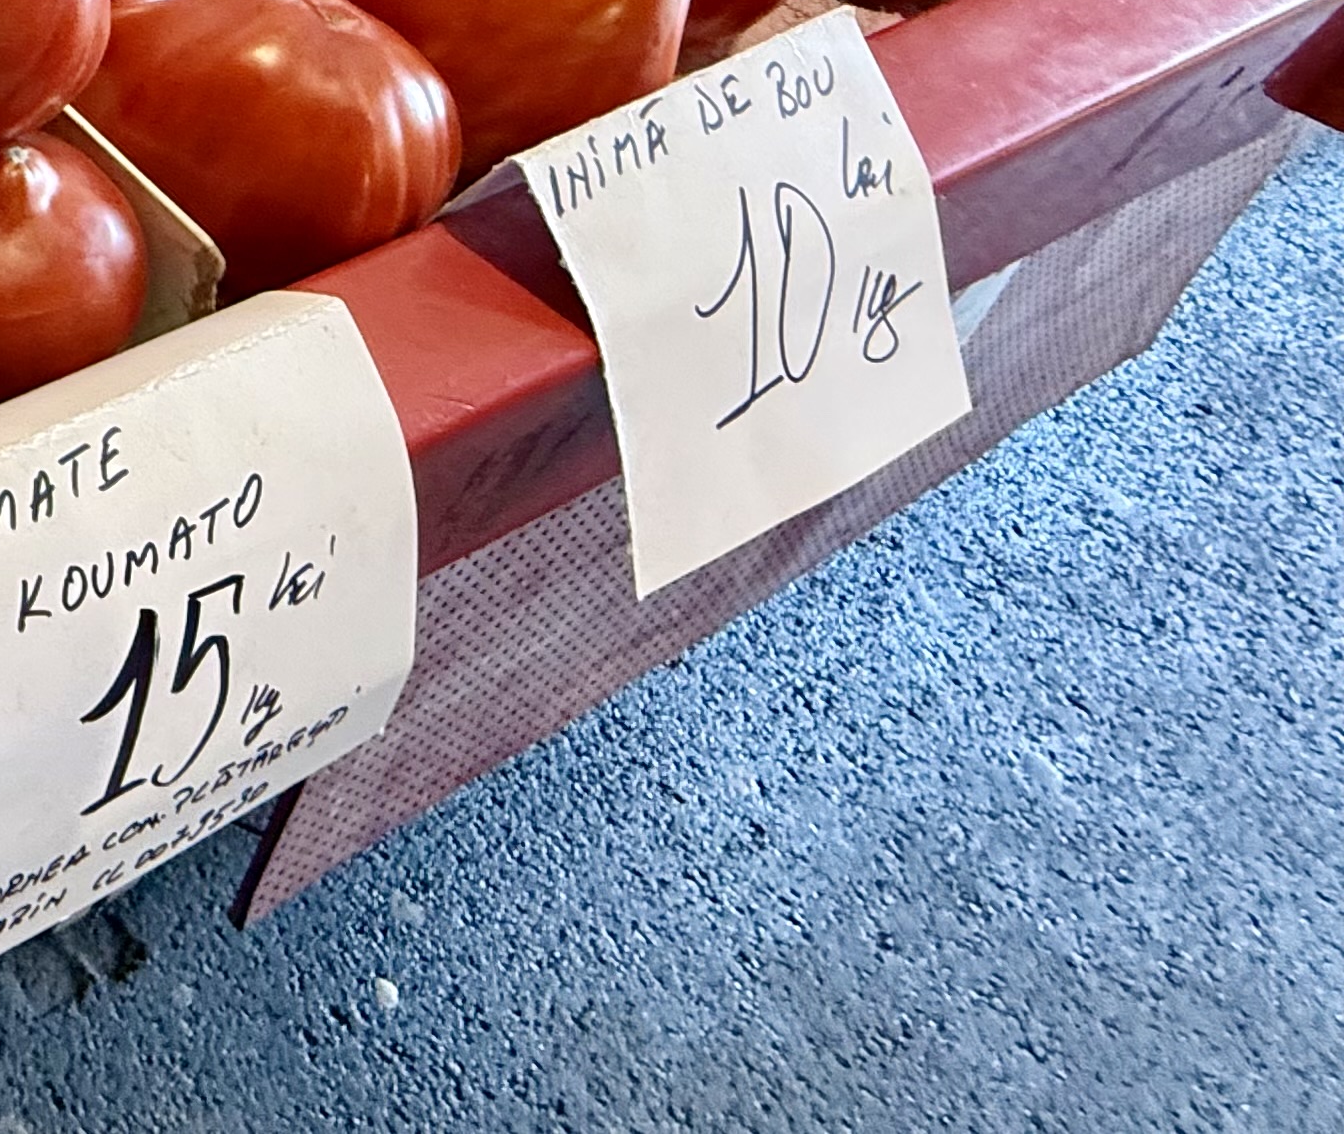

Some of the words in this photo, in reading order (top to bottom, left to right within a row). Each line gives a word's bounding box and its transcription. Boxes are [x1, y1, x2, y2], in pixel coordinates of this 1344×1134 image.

[694, 74, 752, 135] DE
[766, 56, 834, 119] BOU
[694, 182, 835, 430] 10
[18, 473, 263, 632] KOUMATO
[80, 574, 245, 816] 15
